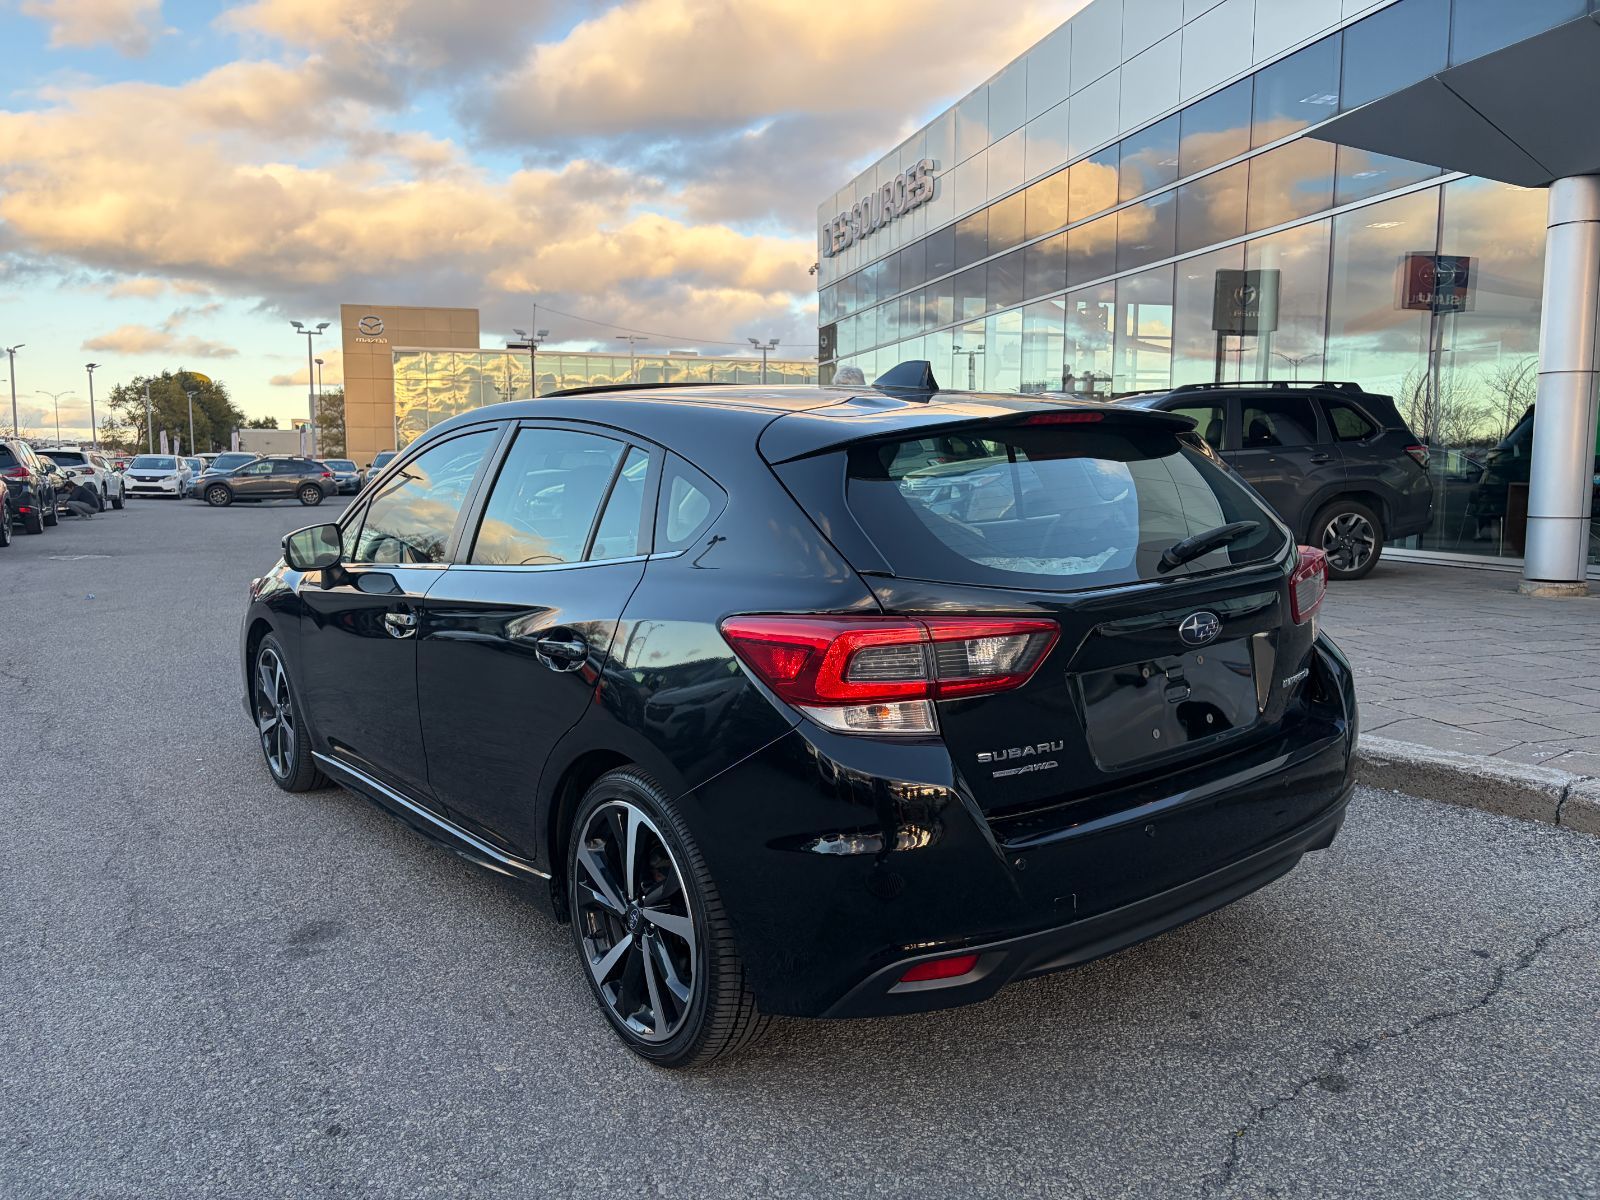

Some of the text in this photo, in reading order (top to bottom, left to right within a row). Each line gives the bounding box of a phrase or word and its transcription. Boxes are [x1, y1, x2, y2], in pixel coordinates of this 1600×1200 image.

[822, 159, 936, 258] DES SOURCES
[977, 740, 1064, 763] SUBARU
[1018, 760, 1059, 775] AWD
